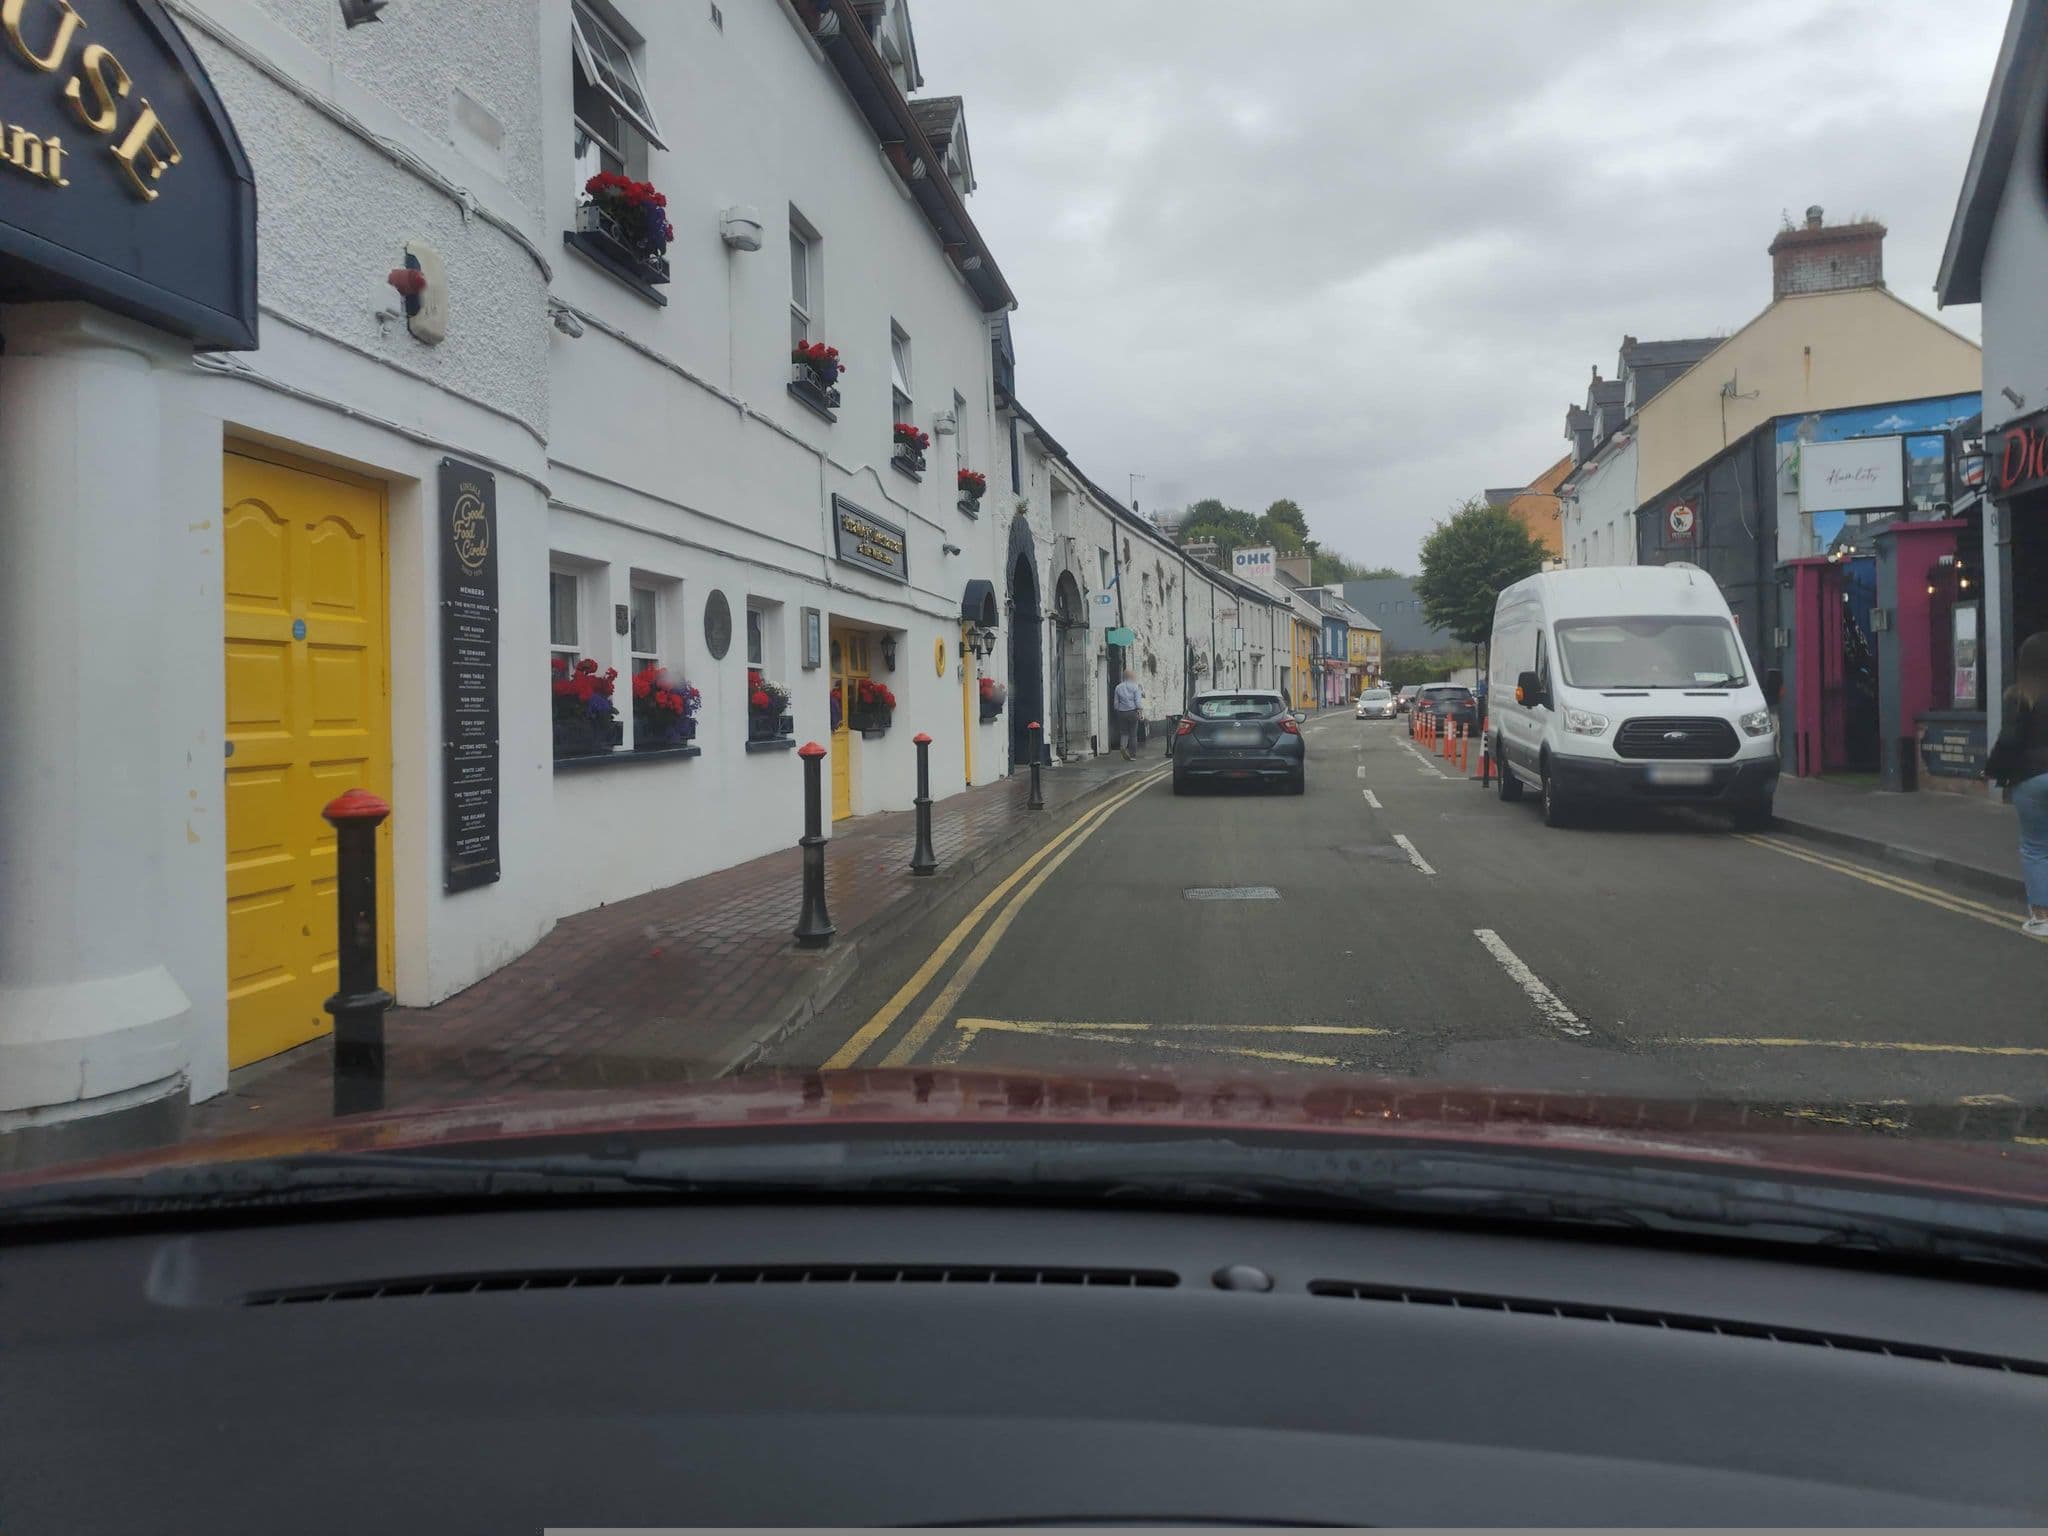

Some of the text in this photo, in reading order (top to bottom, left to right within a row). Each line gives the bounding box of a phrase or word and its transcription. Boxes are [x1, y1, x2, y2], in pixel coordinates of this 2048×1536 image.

[462, 501, 486, 527] Good
[453, 519, 476, 540] Food
[462, 539, 488, 558] Circle
[1236, 553, 1271, 565] OHK
